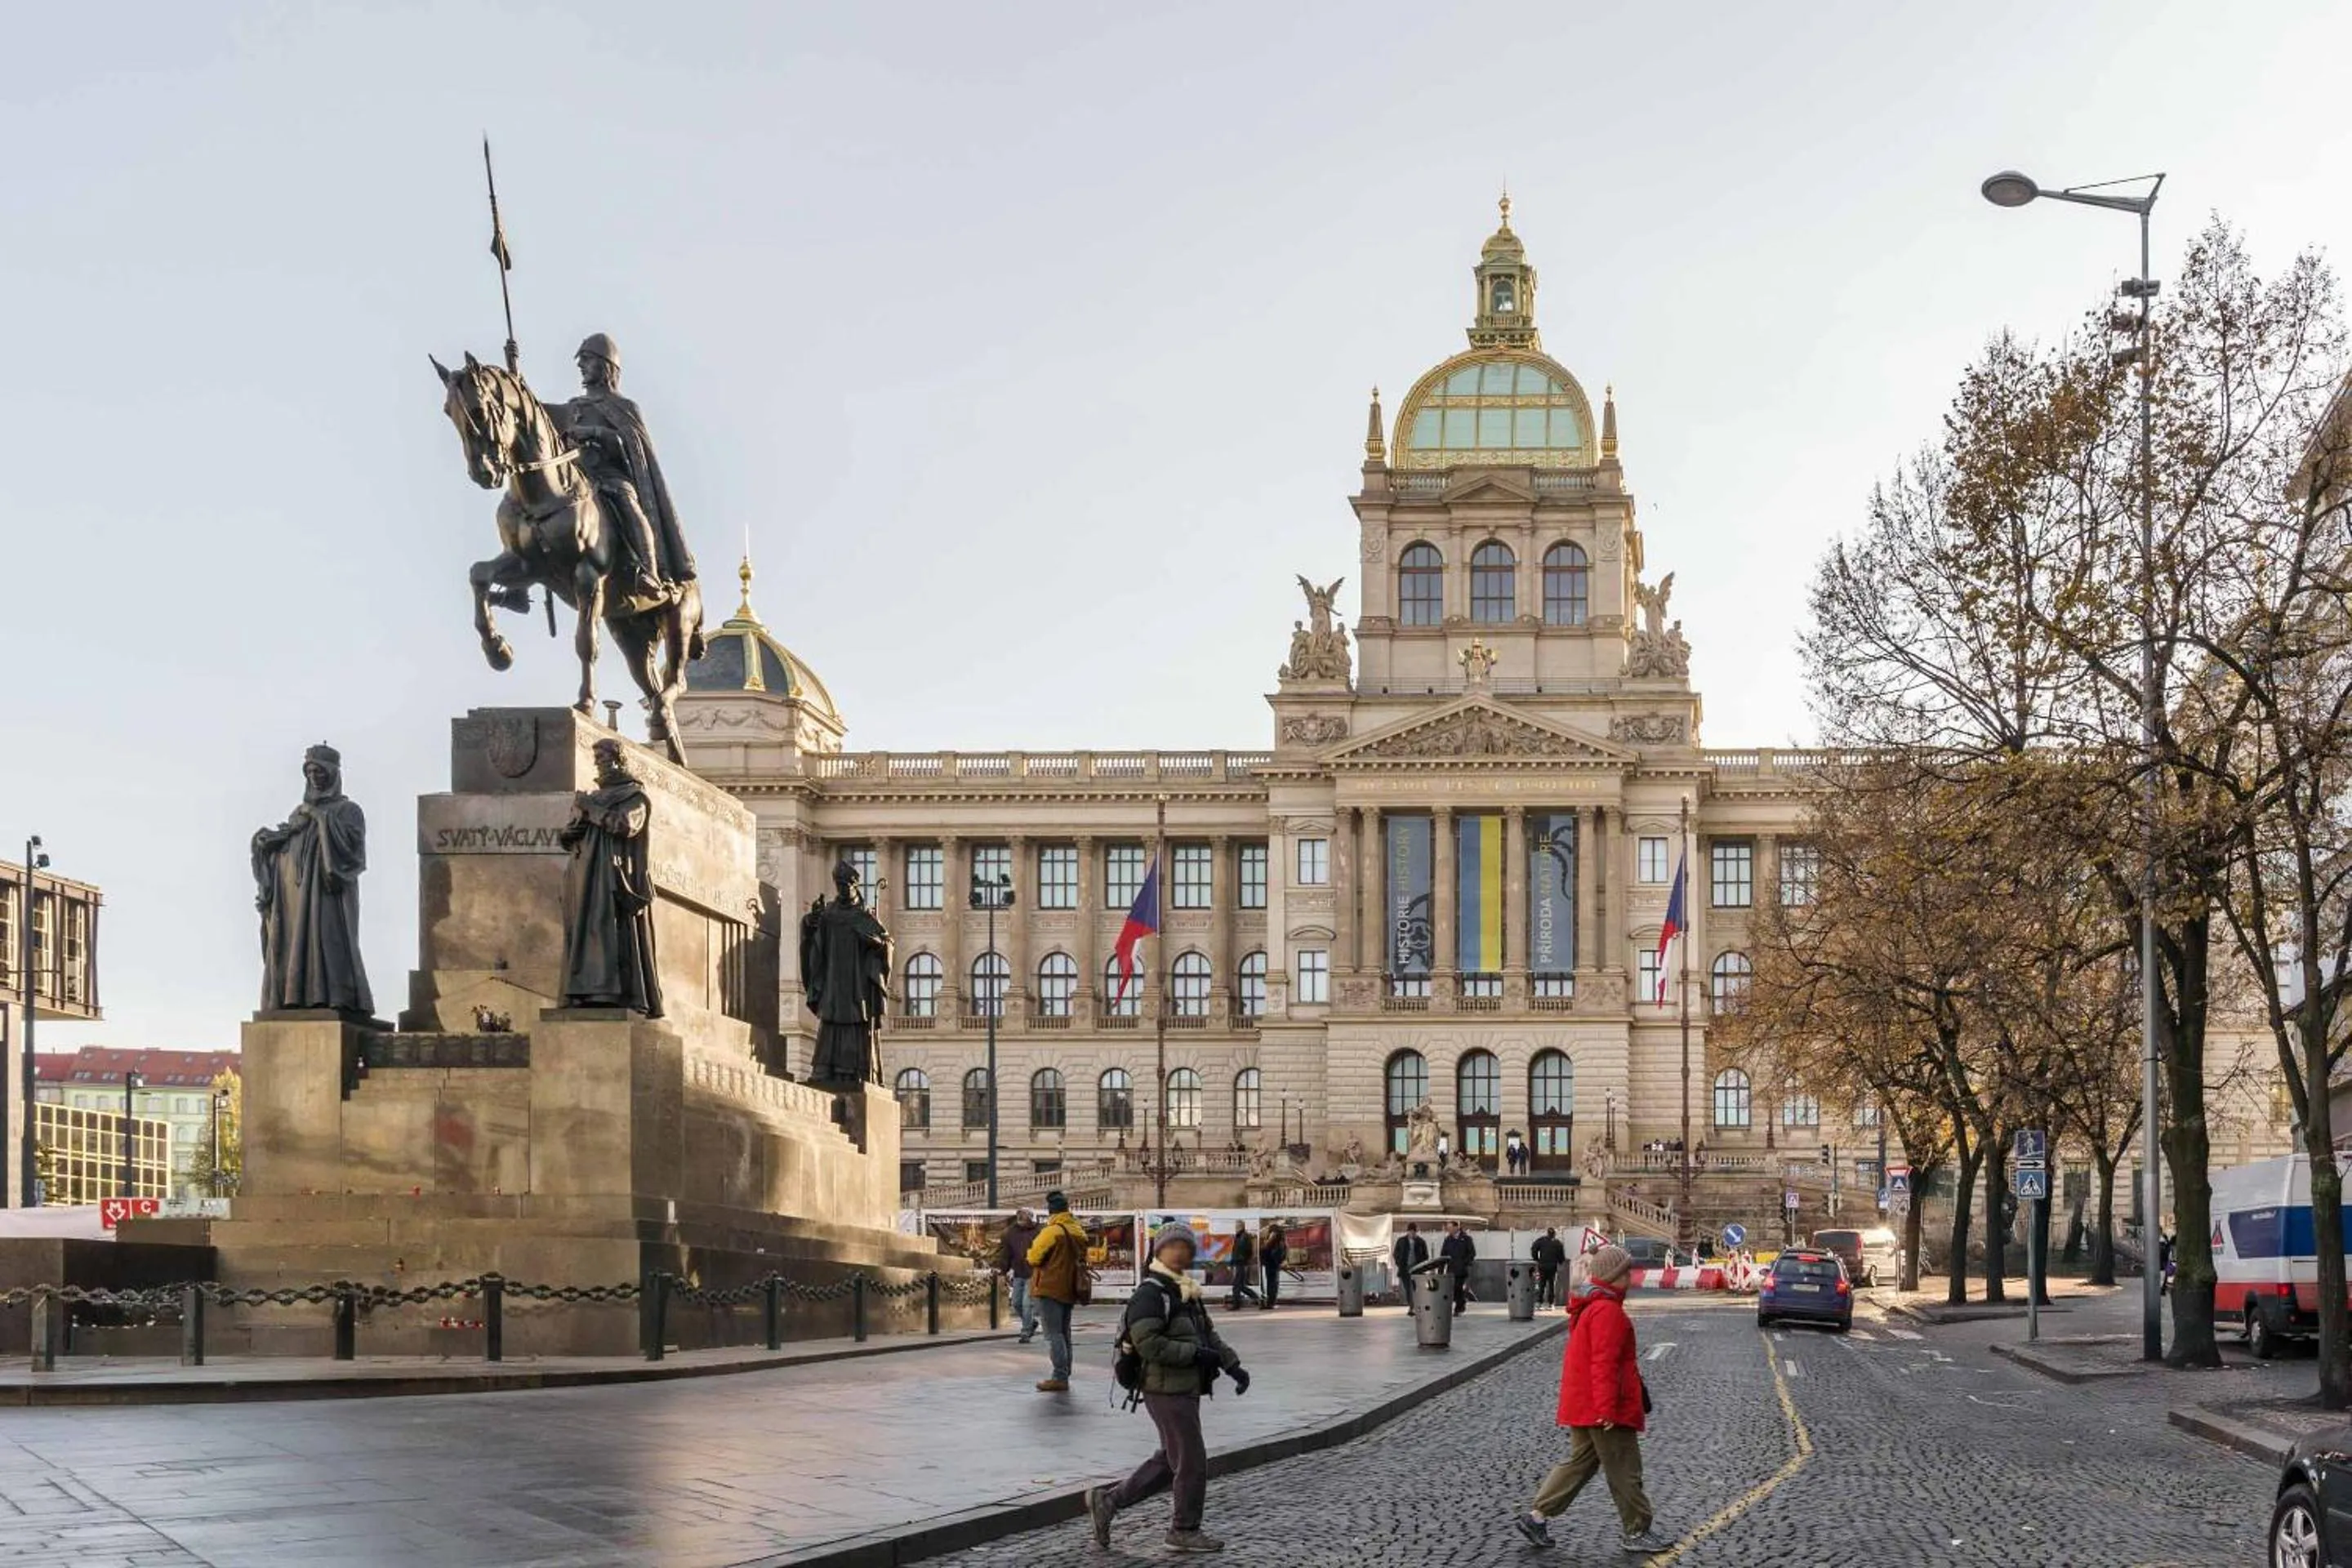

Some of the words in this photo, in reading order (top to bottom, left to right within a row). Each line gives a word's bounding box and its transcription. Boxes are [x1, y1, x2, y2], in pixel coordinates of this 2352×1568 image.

[1396, 826, 1410, 891] HISTORY
[1539, 831, 1552, 895] NATURE
[1397, 895, 1410, 964] HISTORIE
[140, 1200, 151, 1213] C
